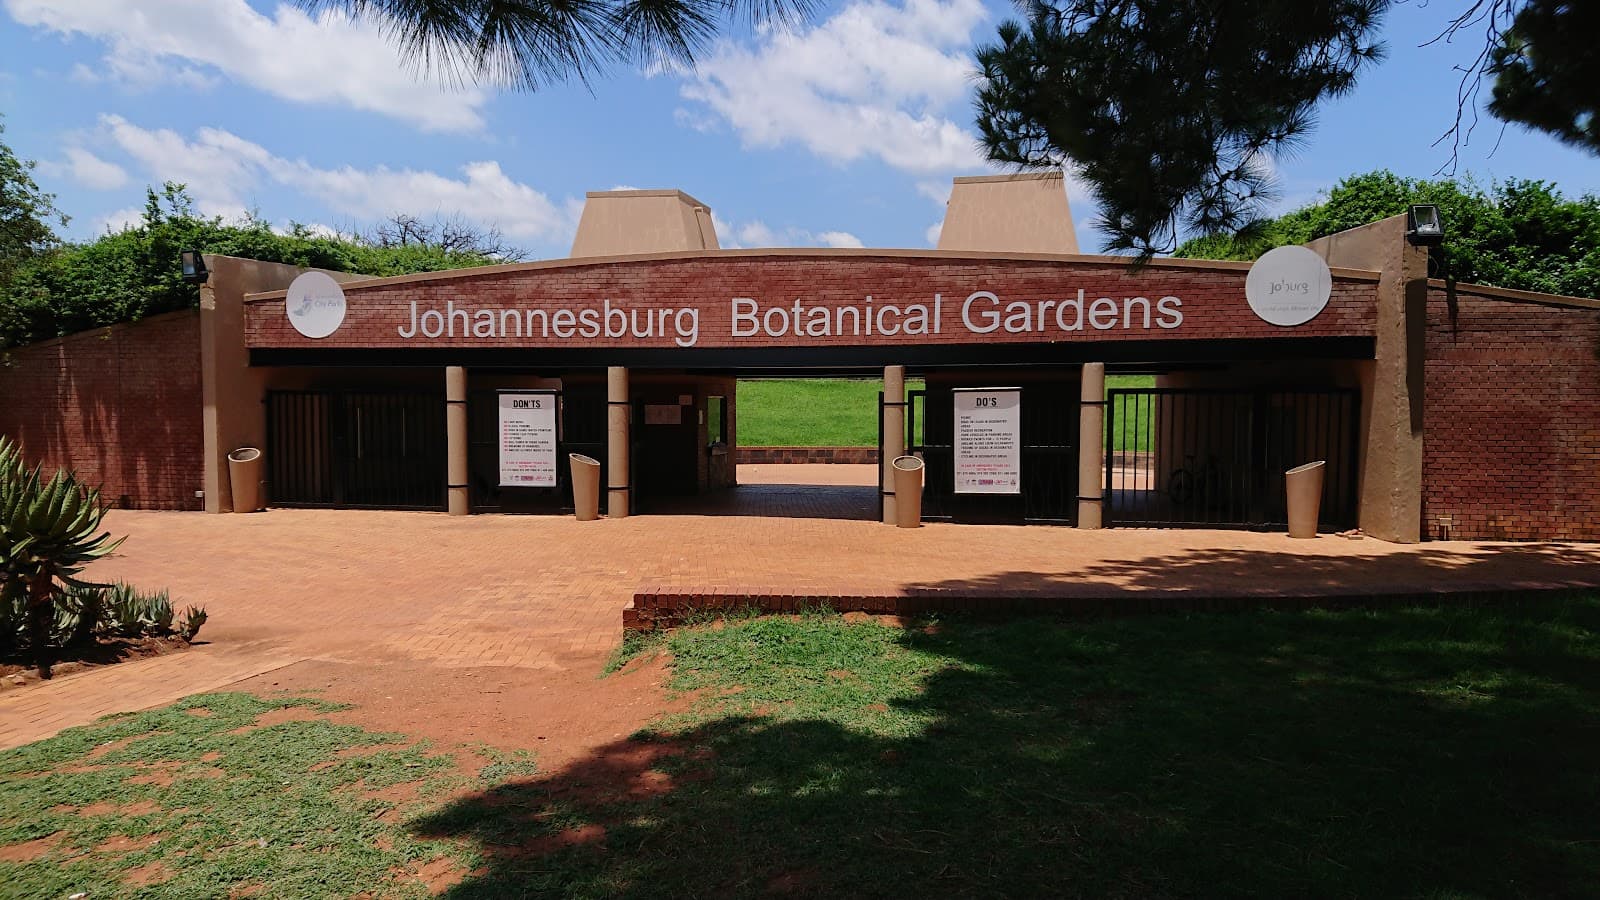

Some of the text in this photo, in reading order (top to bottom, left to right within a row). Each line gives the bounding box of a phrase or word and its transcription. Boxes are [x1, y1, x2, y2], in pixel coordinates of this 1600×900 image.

[397, 288, 1184, 347] Johannesburg Botanical Gardens
[513, 399, 541, 408] DON'TS
[976, 397, 997, 407] DO'S
